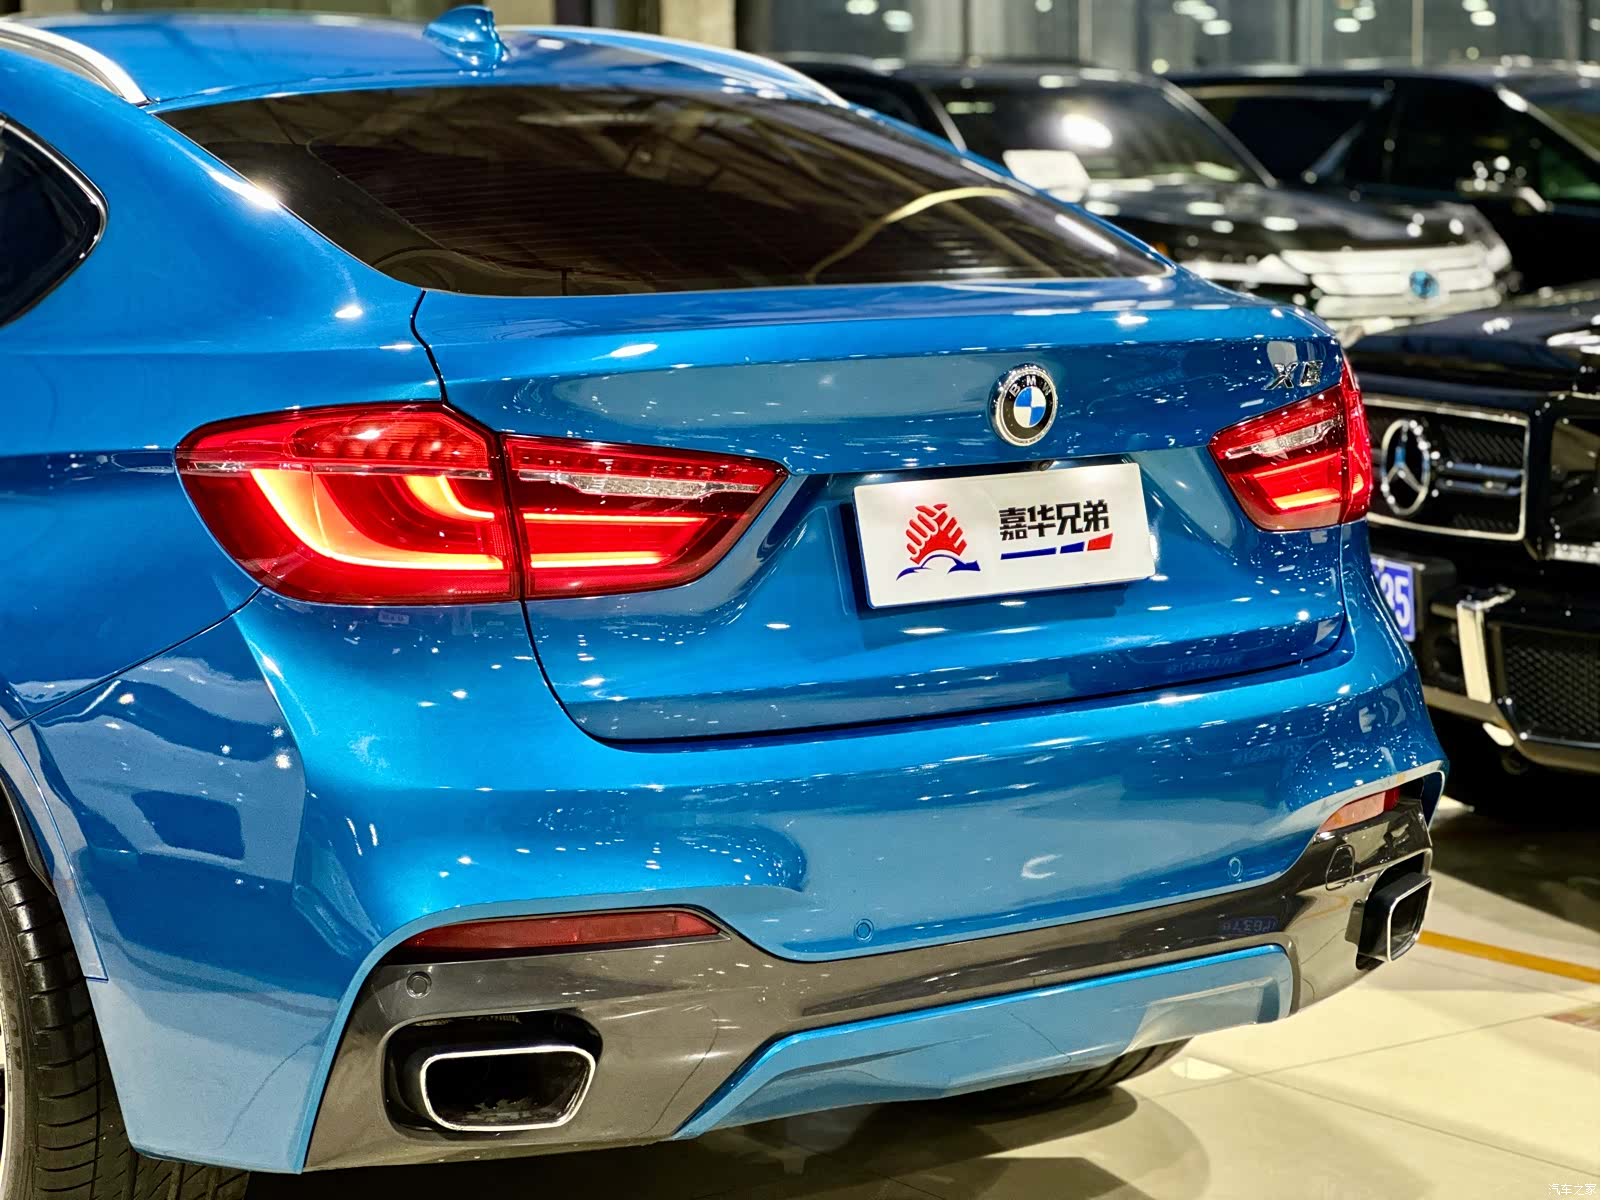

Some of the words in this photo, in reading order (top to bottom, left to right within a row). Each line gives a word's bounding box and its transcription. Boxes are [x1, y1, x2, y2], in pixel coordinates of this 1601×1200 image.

[1009, 375, 1052, 397] BMW
[998, 499, 1110, 541] 嘉华兄弟
